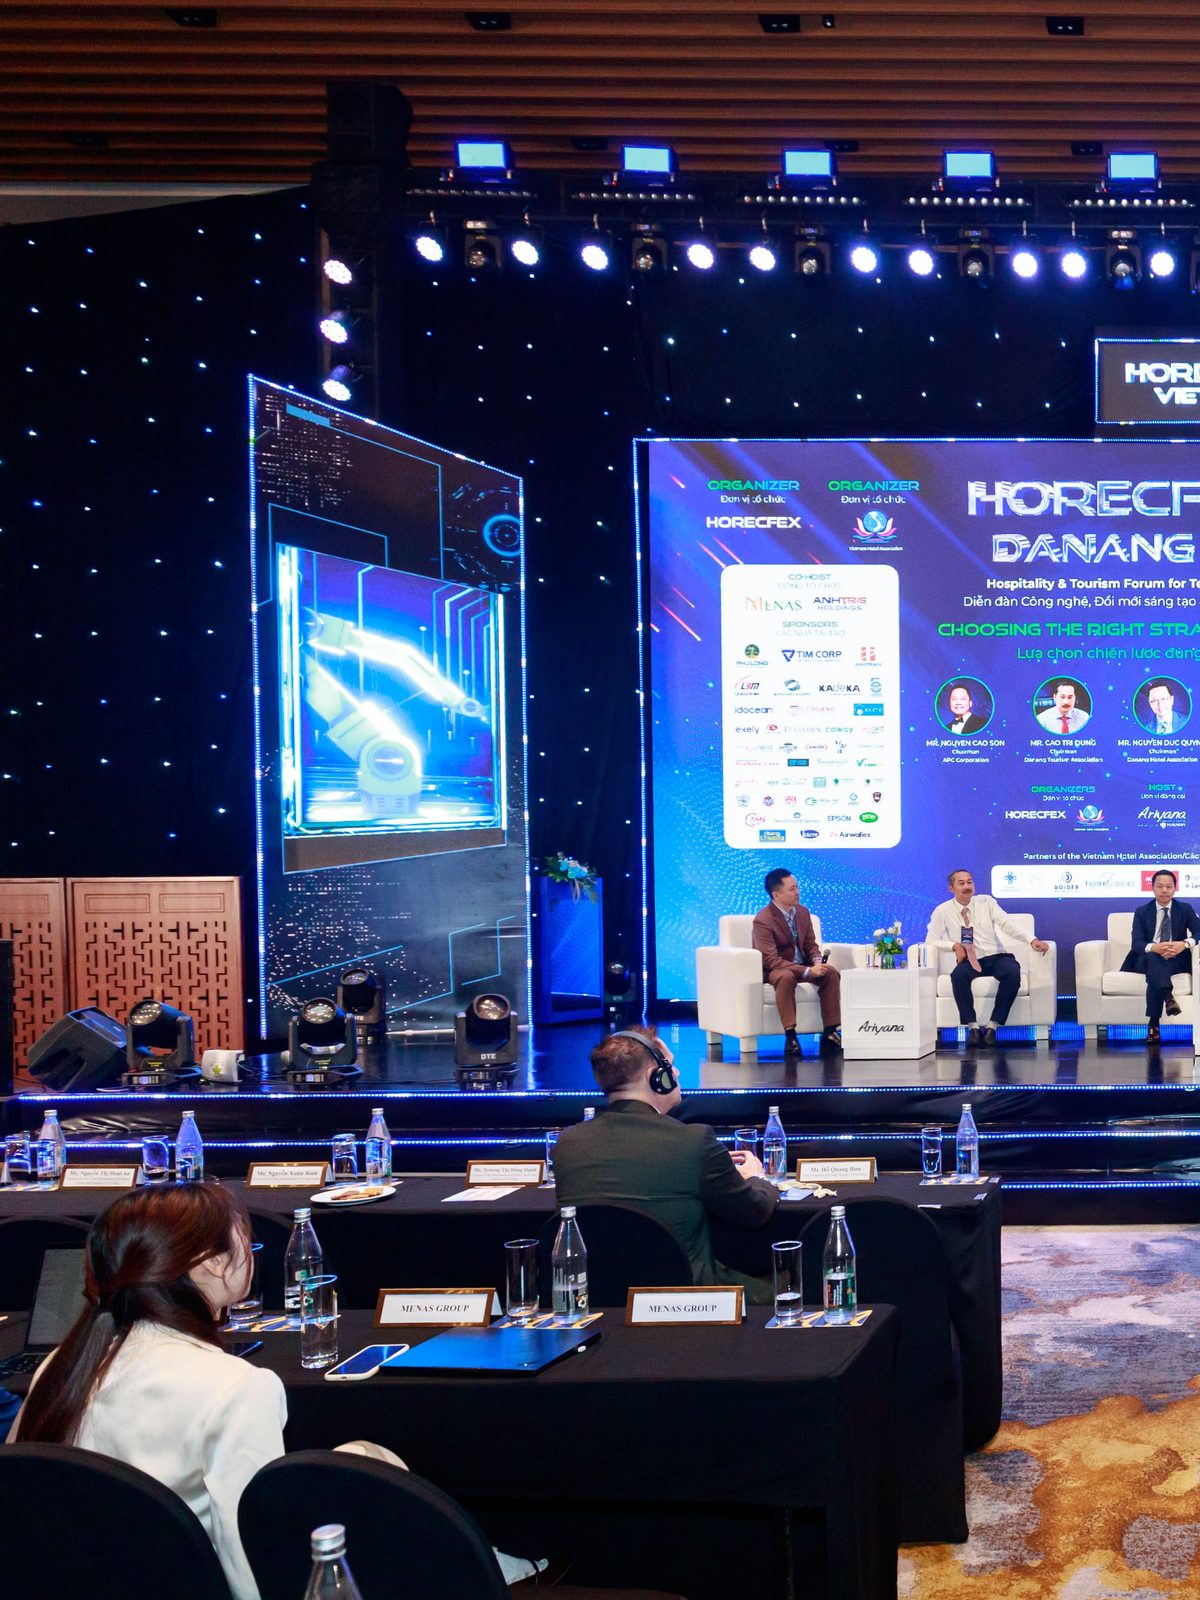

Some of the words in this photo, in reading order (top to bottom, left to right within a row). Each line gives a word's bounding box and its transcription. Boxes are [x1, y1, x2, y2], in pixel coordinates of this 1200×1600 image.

[708, 480, 800, 491] ORGANIZER
[828, 480, 920, 491] ORGANIZER
[706, 516, 801, 529] HORECFEX
[992, 533, 1195, 563] DANANG
[987, 578, 1055, 592] Hospitality
[1058, 579, 1067, 589] &
[1070, 578, 1121, 589] Tourism
[1124, 579, 1165, 589] Forum
[1168, 578, 1186, 589] for
[745, 596, 802, 611] MENAS
[963, 594, 992, 606] Diễn
[995, 595, 1018, 606] đàn
[1022, 595, 1053, 609] Công
[1056, 595, 1091, 609] nghệ,
[1094, 594, 1115, 606] Đổi
[1118, 595, 1142, 606] mới
[1144, 595, 1174, 609] sáng
[1177, 596, 1197, 608] tạo
[938, 623, 1041, 636] CHOOSING
[1046, 623, 1083, 636] THE
[1087, 623, 1145, 636] RIGHT
[797, 650, 813, 658] TIM
[816, 650, 842, 658] CORP
[735, 705, 772, 714] idocean
[735, 726, 760, 734] exely
[1138, 807, 1186, 822] Ariyana
[1058, 852, 1066, 860] of
[1067, 852, 1080, 860] the
[858, 1020, 905, 1035] Ariyana
[401, 1304, 434, 1313] MENAS
[436, 1304, 470, 1313] GROUP
[649, 1304, 682, 1313] MENAS
[683, 1303, 717, 1313] GROUP
